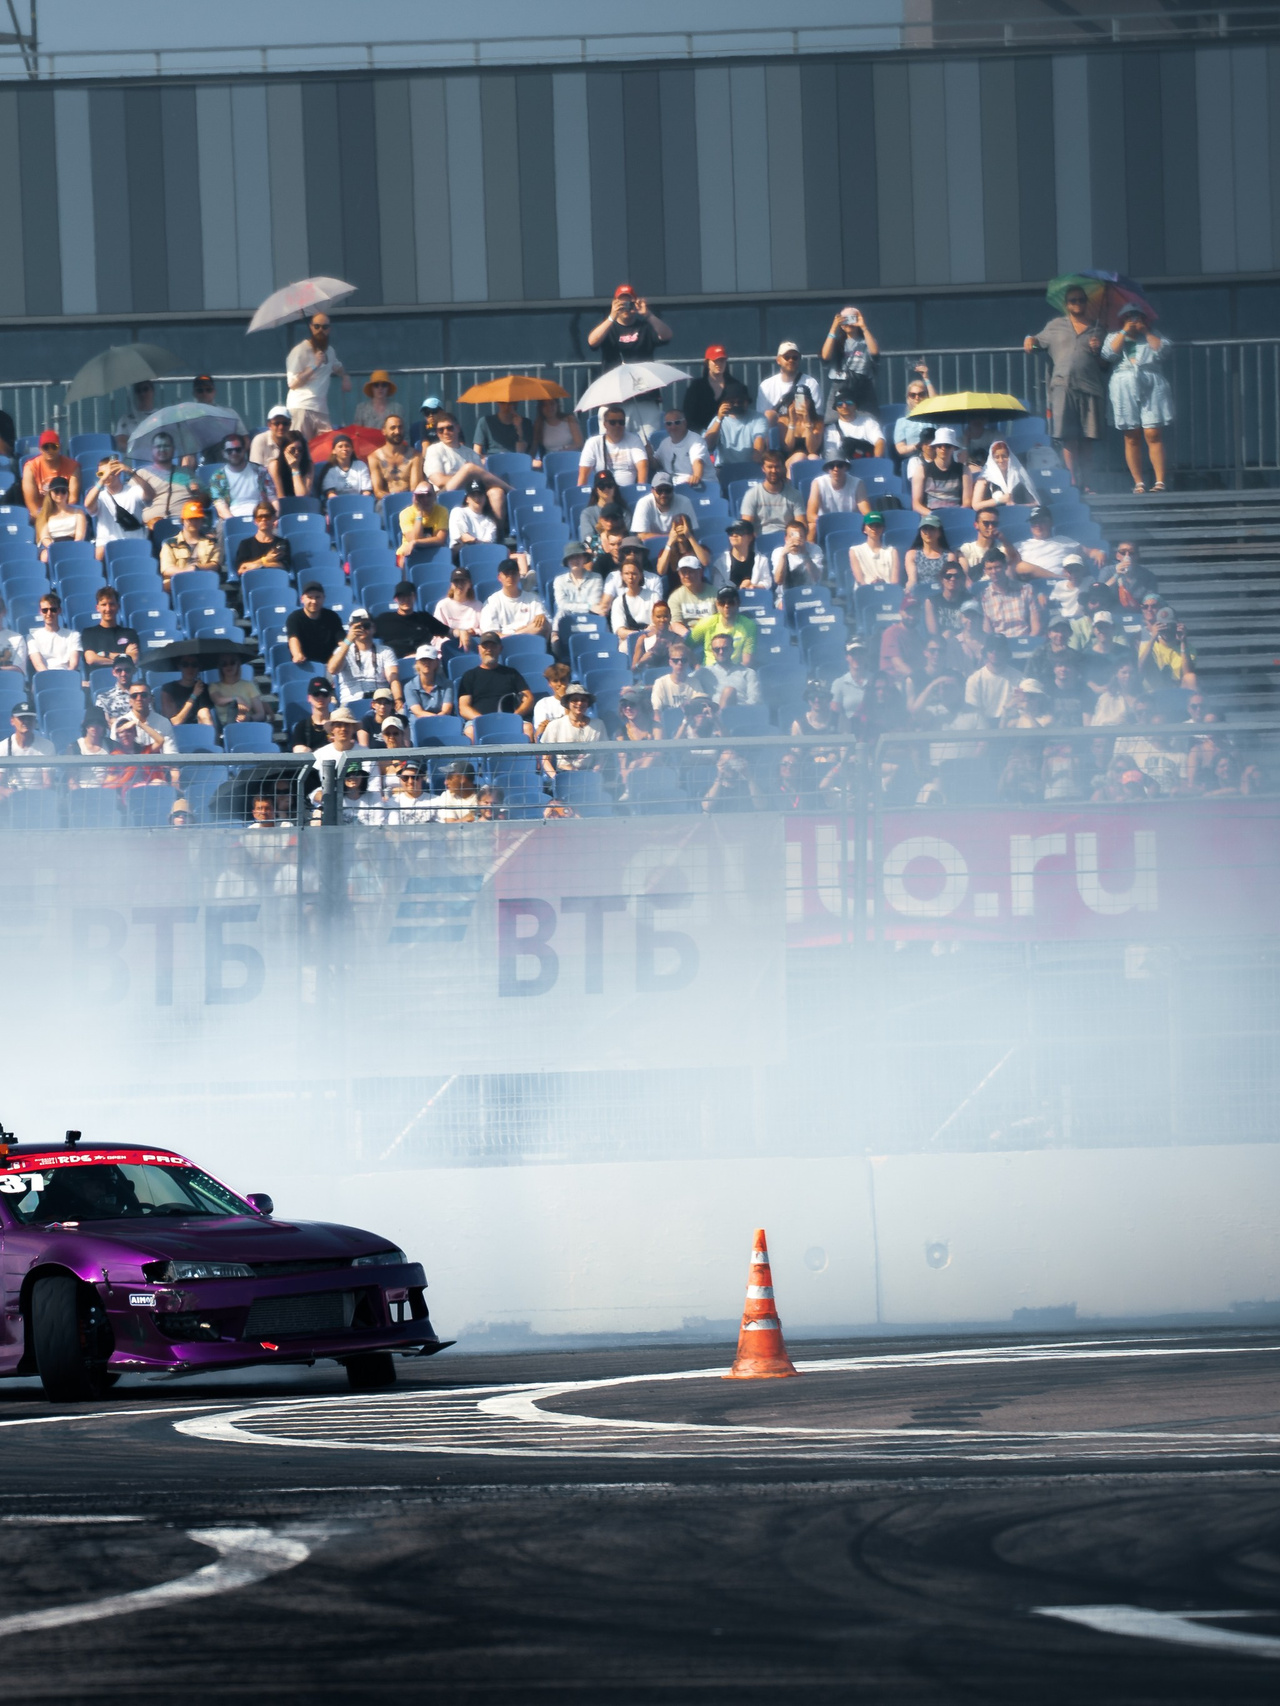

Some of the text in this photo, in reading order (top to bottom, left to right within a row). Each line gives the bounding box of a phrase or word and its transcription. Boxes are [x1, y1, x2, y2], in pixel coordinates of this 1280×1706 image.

[71, 904, 266, 1006] ВТБ
[498, 892, 700, 998] ВТБ
[142, 1154, 185, 1164] PRO
